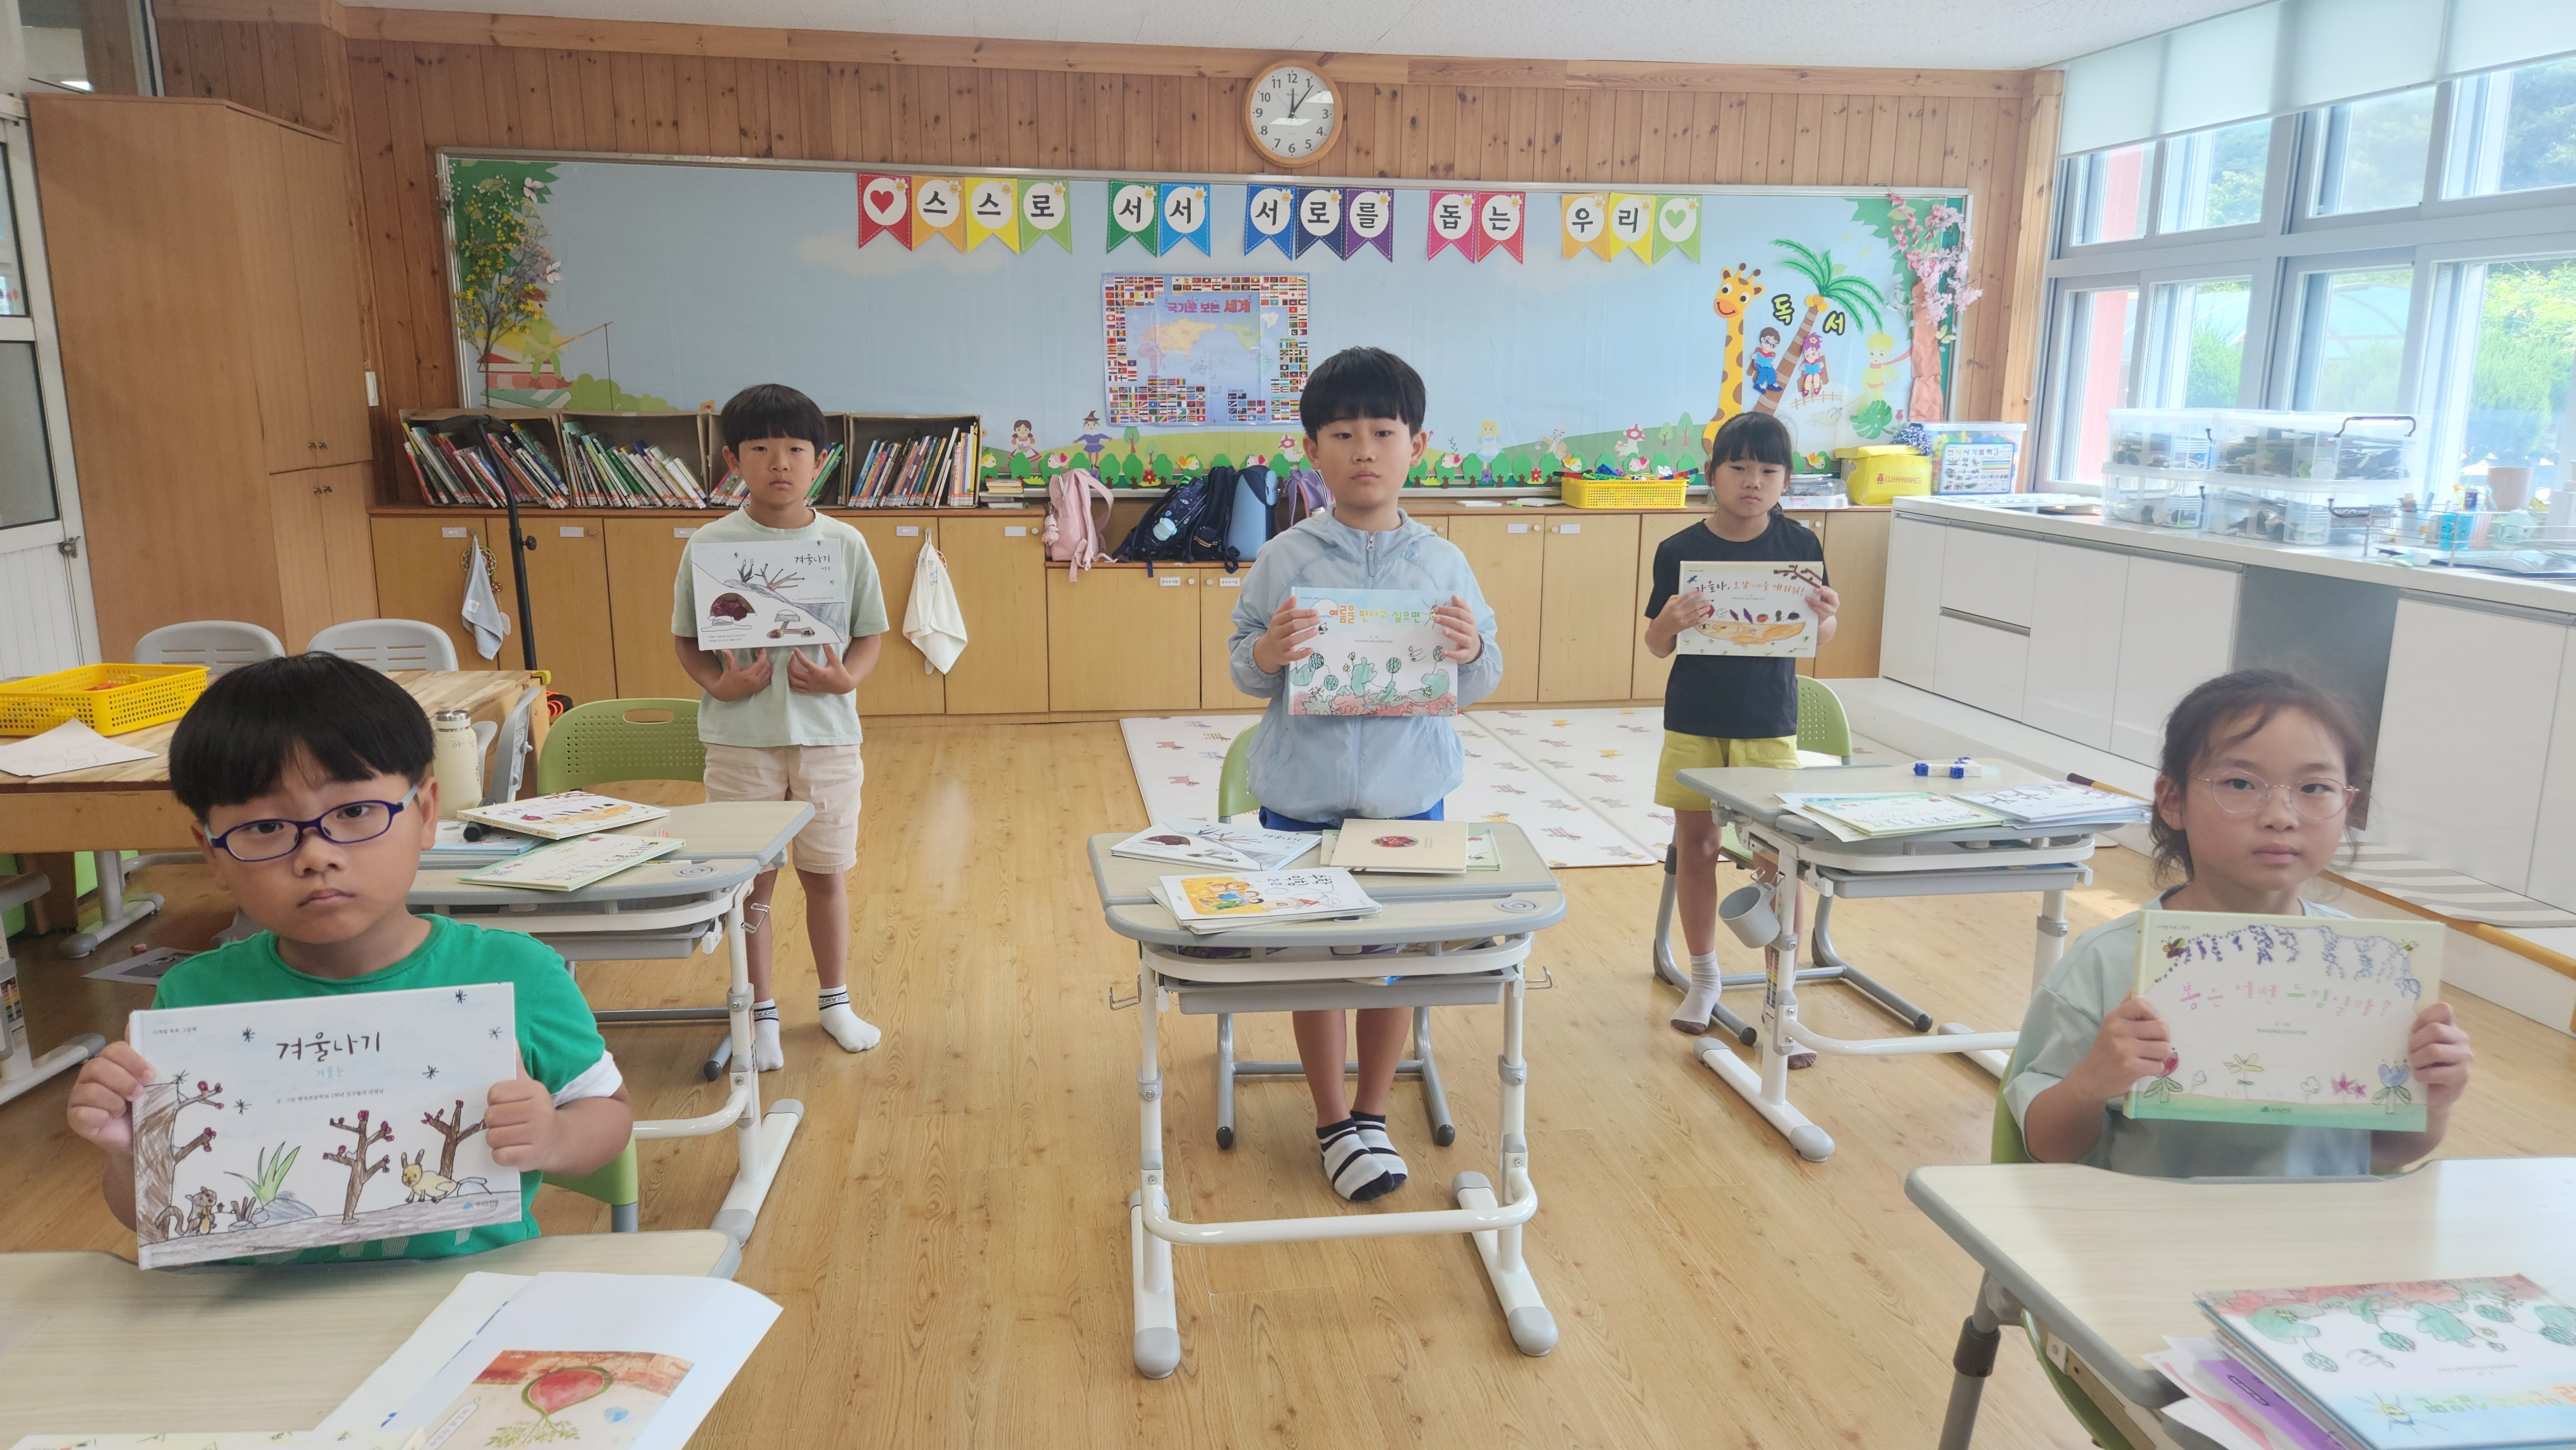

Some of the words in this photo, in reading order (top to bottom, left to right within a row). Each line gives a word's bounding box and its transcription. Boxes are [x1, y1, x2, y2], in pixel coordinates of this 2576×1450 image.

[1271, 78, 1281, 88] 11
[1287, 73, 1297, 83] 12
[1305, 78, 1310, 88] 1
[1260, 92, 1271, 102] 10
[1255, 108, 1263, 117] 9
[1322, 109, 1329, 119] 3
[1260, 126, 1268, 135] 8
[1316, 126, 1323, 136] 4
[1273, 138, 1281, 148] 7
[1288, 143, 1296, 153] 6
[1304, 139, 1312, 149] 5
[923, 191, 1054, 217] 스스로
[1118, 196, 1192, 224] 서서
[1255, 199, 1379, 229] 서로를
[1440, 204, 1511, 231] 돕는
[1571, 207, 1638, 234] 우리
[1167, 299, 1198, 313] 국기로
[1200, 302, 1220, 313] 보는
[1224, 299, 1251, 313] 세계
[794, 553, 830, 565] 겨울나기
[1329, 605, 1355, 624] 여름을
[1359, 610, 1387, 623] 만나고
[1392, 611, 1420, 623] 싶으면
[2179, 983, 2224, 1010] 봄은
[2235, 981, 2276, 1005] 어떤
[276, 1031, 380, 1062] 겨울나기
